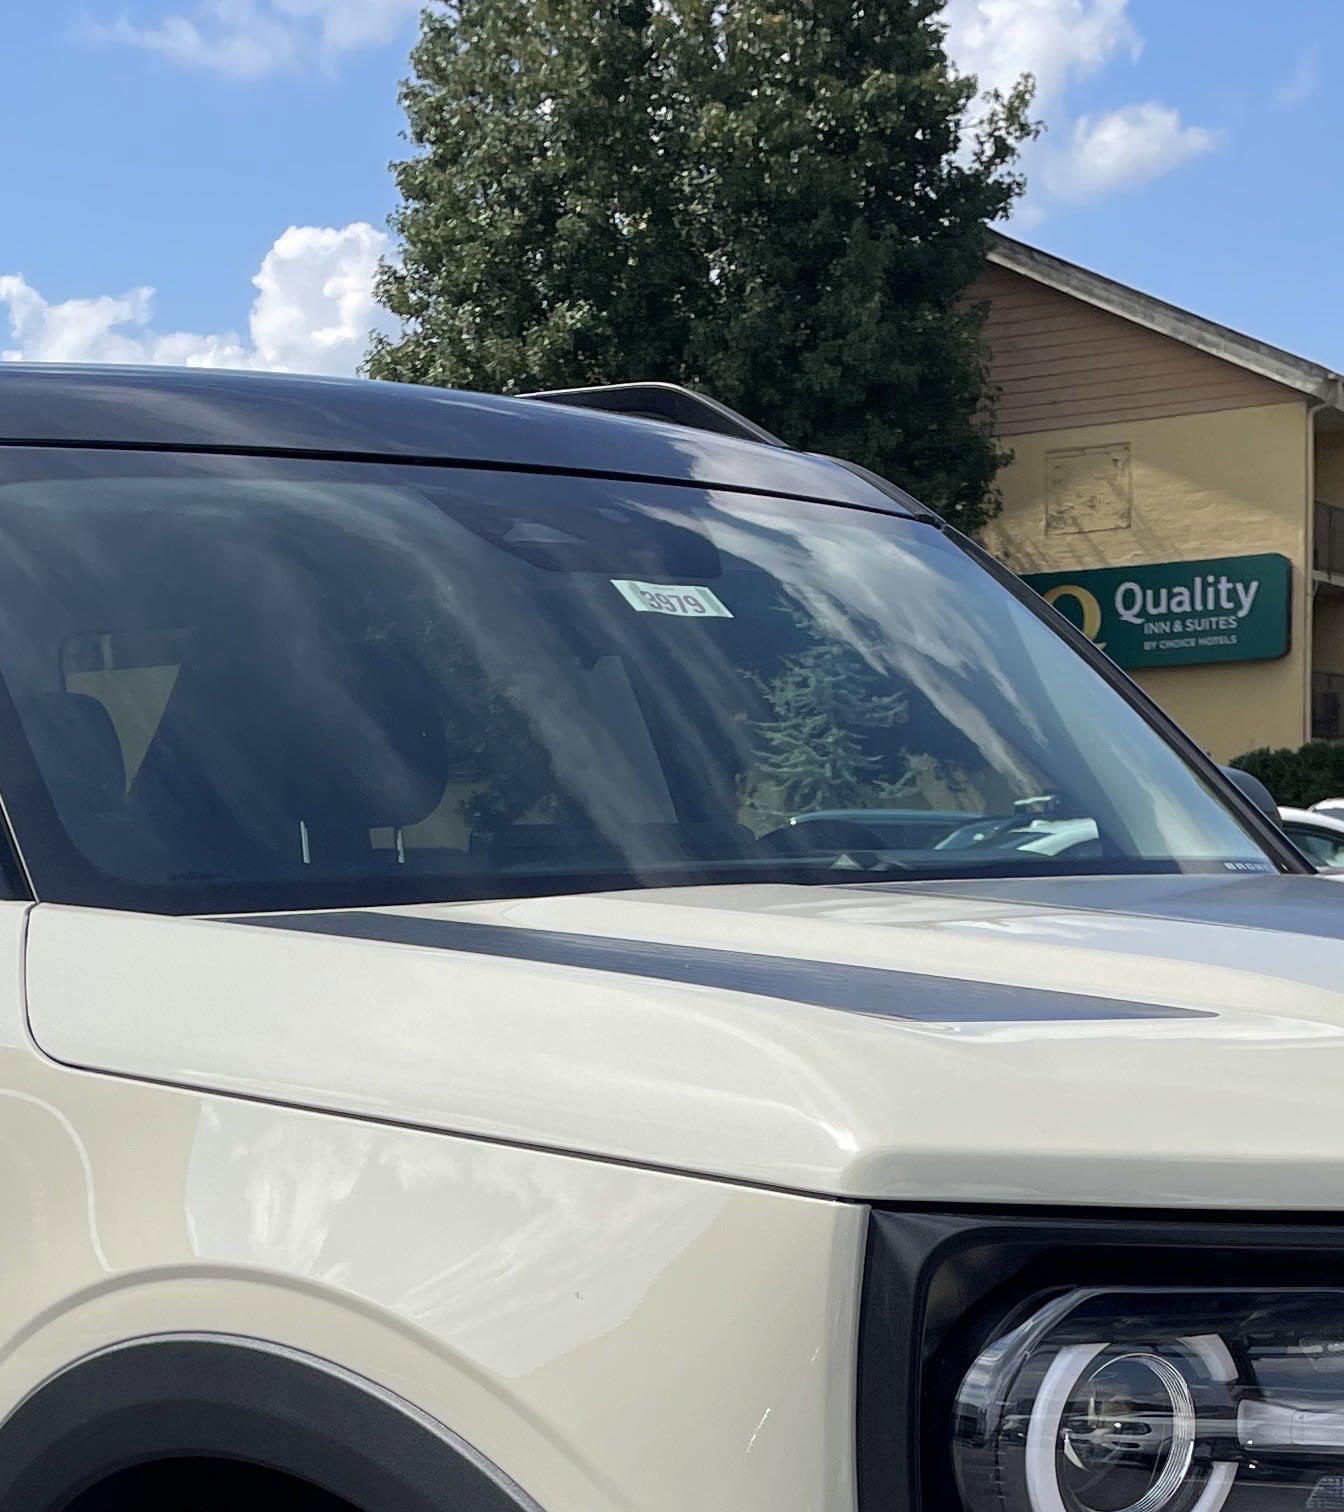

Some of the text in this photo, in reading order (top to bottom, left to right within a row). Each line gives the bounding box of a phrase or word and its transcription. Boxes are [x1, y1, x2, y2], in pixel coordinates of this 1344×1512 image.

[639, 590, 706, 614] 3979
[1114, 575, 1259, 625] Quality
[1144, 615, 1238, 634] INN & SUITES
[1159, 638, 1196, 649] CHOICE
[1198, 635, 1238, 646] HOTELS
